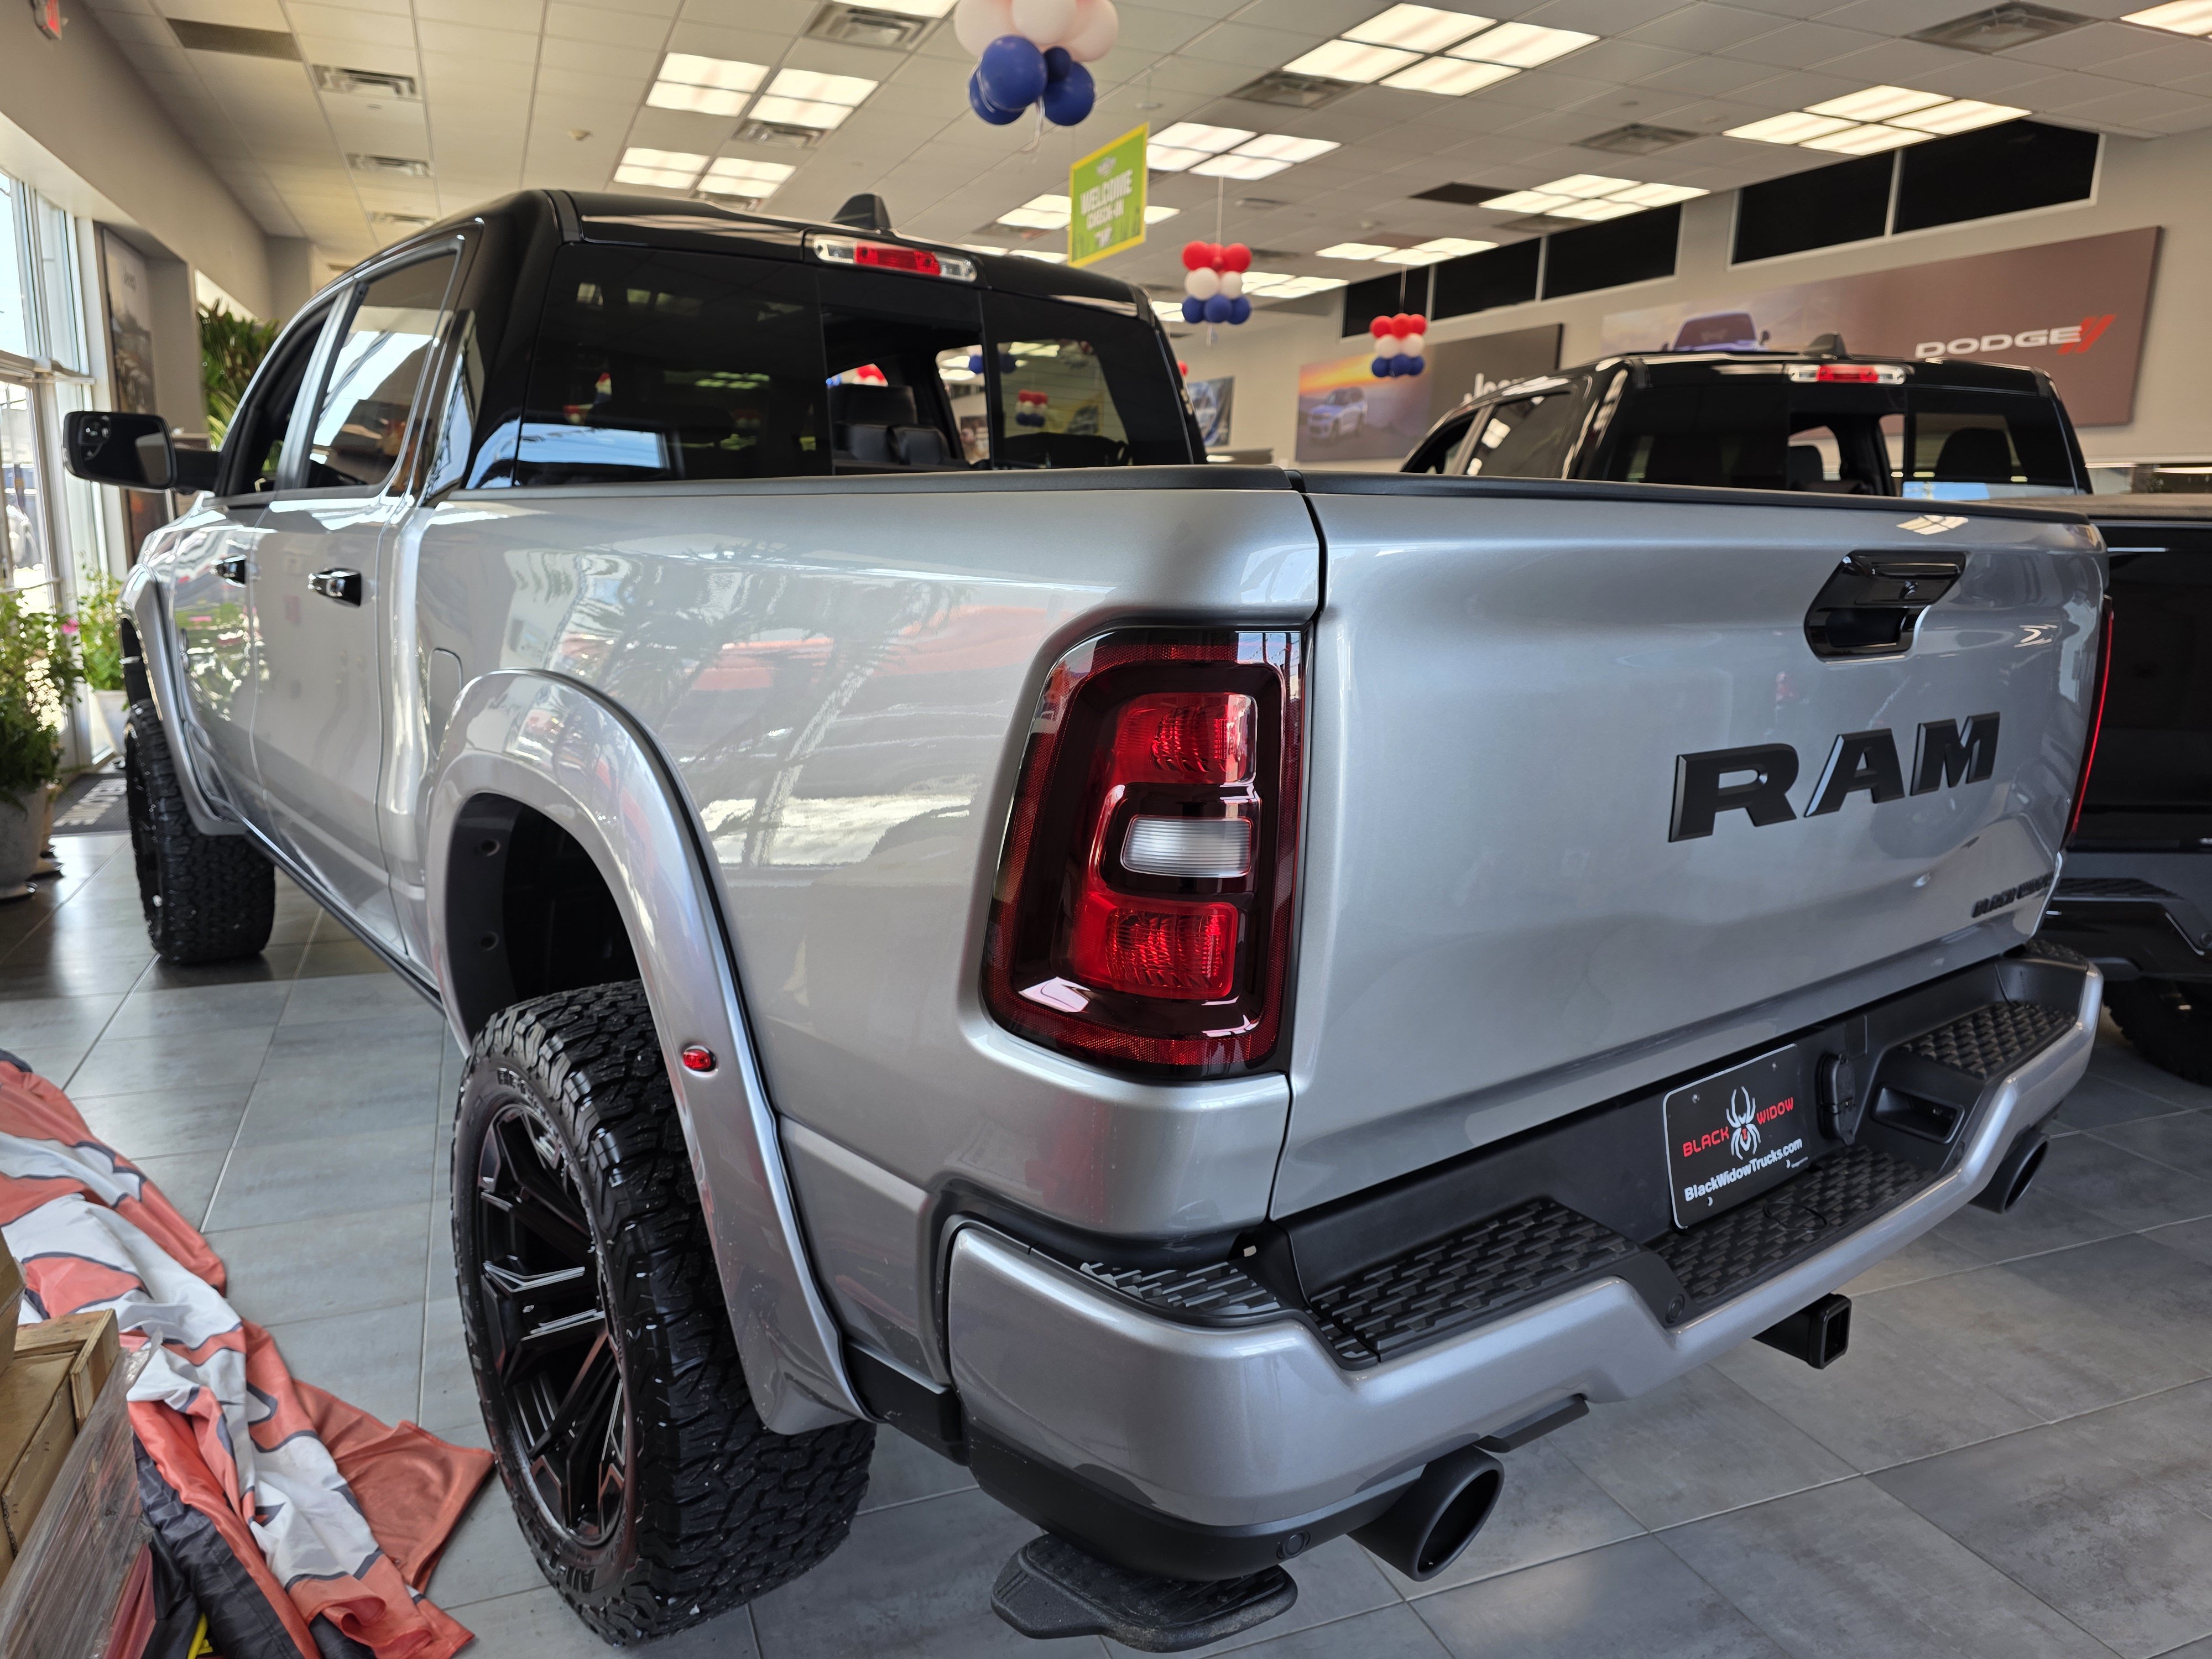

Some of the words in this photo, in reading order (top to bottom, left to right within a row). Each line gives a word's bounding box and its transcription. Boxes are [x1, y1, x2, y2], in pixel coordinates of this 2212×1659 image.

[1080, 168, 1133, 216] WELCOME
[1915, 325, 2083, 358] DODGE
[1668, 712, 2000, 843] RAM
[1683, 1126, 1730, 1157] BLACK
[1756, 1097, 1794, 1125] WIDOW
[1684, 1138, 1803, 1202] BlackWidowTrucks.com
